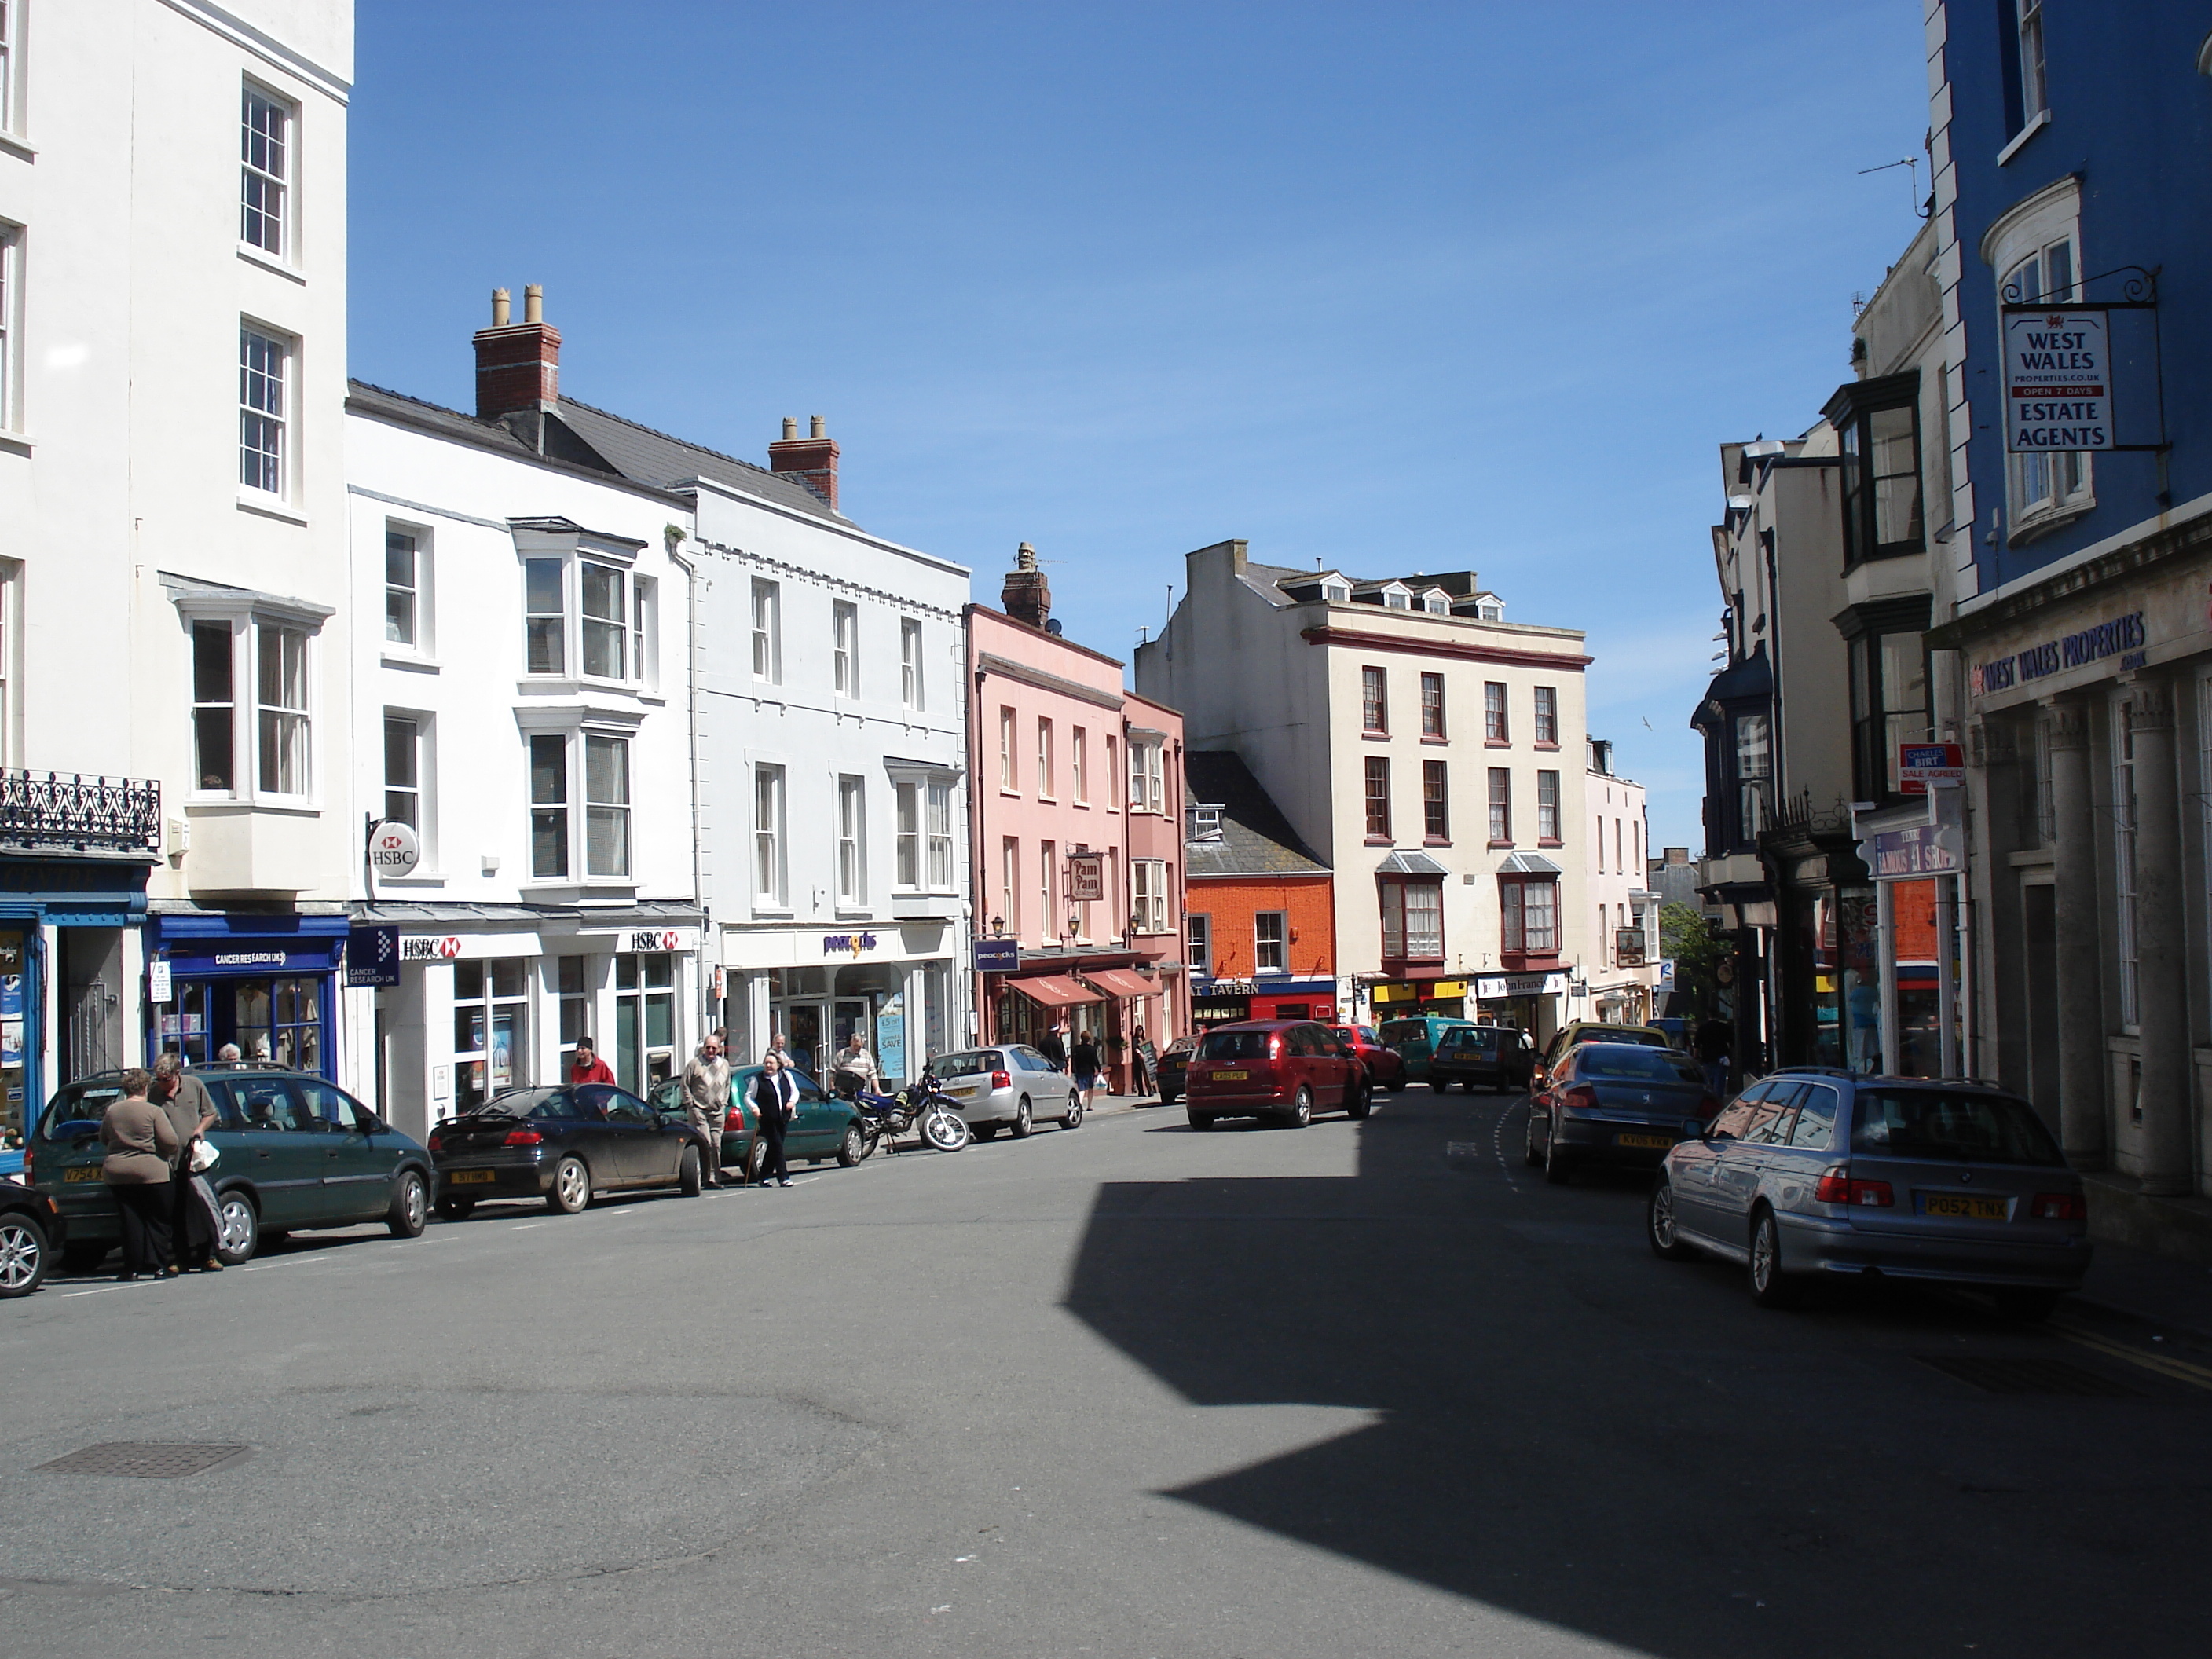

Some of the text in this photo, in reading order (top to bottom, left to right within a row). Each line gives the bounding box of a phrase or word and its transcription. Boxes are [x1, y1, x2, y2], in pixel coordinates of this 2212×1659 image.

[2027, 332, 2085, 350] WEST
[2021, 353, 2094, 370] WALES
[2015, 373, 2100, 383] PROPERTIES.CO.UK
[2020, 402, 2098, 421] ESTATE
[2016, 427, 2105, 446] AGENTS
[1983, 611, 2145, 692] WEST WALES PROPERTIES
[1907, 749, 1944, 759] CHARLES
[1915, 756, 1939, 767] BIRT
[373, 851, 414, 865] HSBC
[1074, 860, 1097, 875] Pam
[4, 866, 97, 892] CENTRE
[1075, 875, 1097, 889] Pam
[404, 939, 440, 957] HSBC
[632, 932, 661, 950] HSBC
[215, 954, 240, 965] CANCER
[272, 953, 280, 962] UK
[978, 951, 1015, 961] peacocks
[1210, 984, 1259, 996] TAVERN
[882, 1039, 902, 1049] SAVE
[67, 1169, 93, 1180] V754
[1975, 1200, 2005, 1218] TNX
